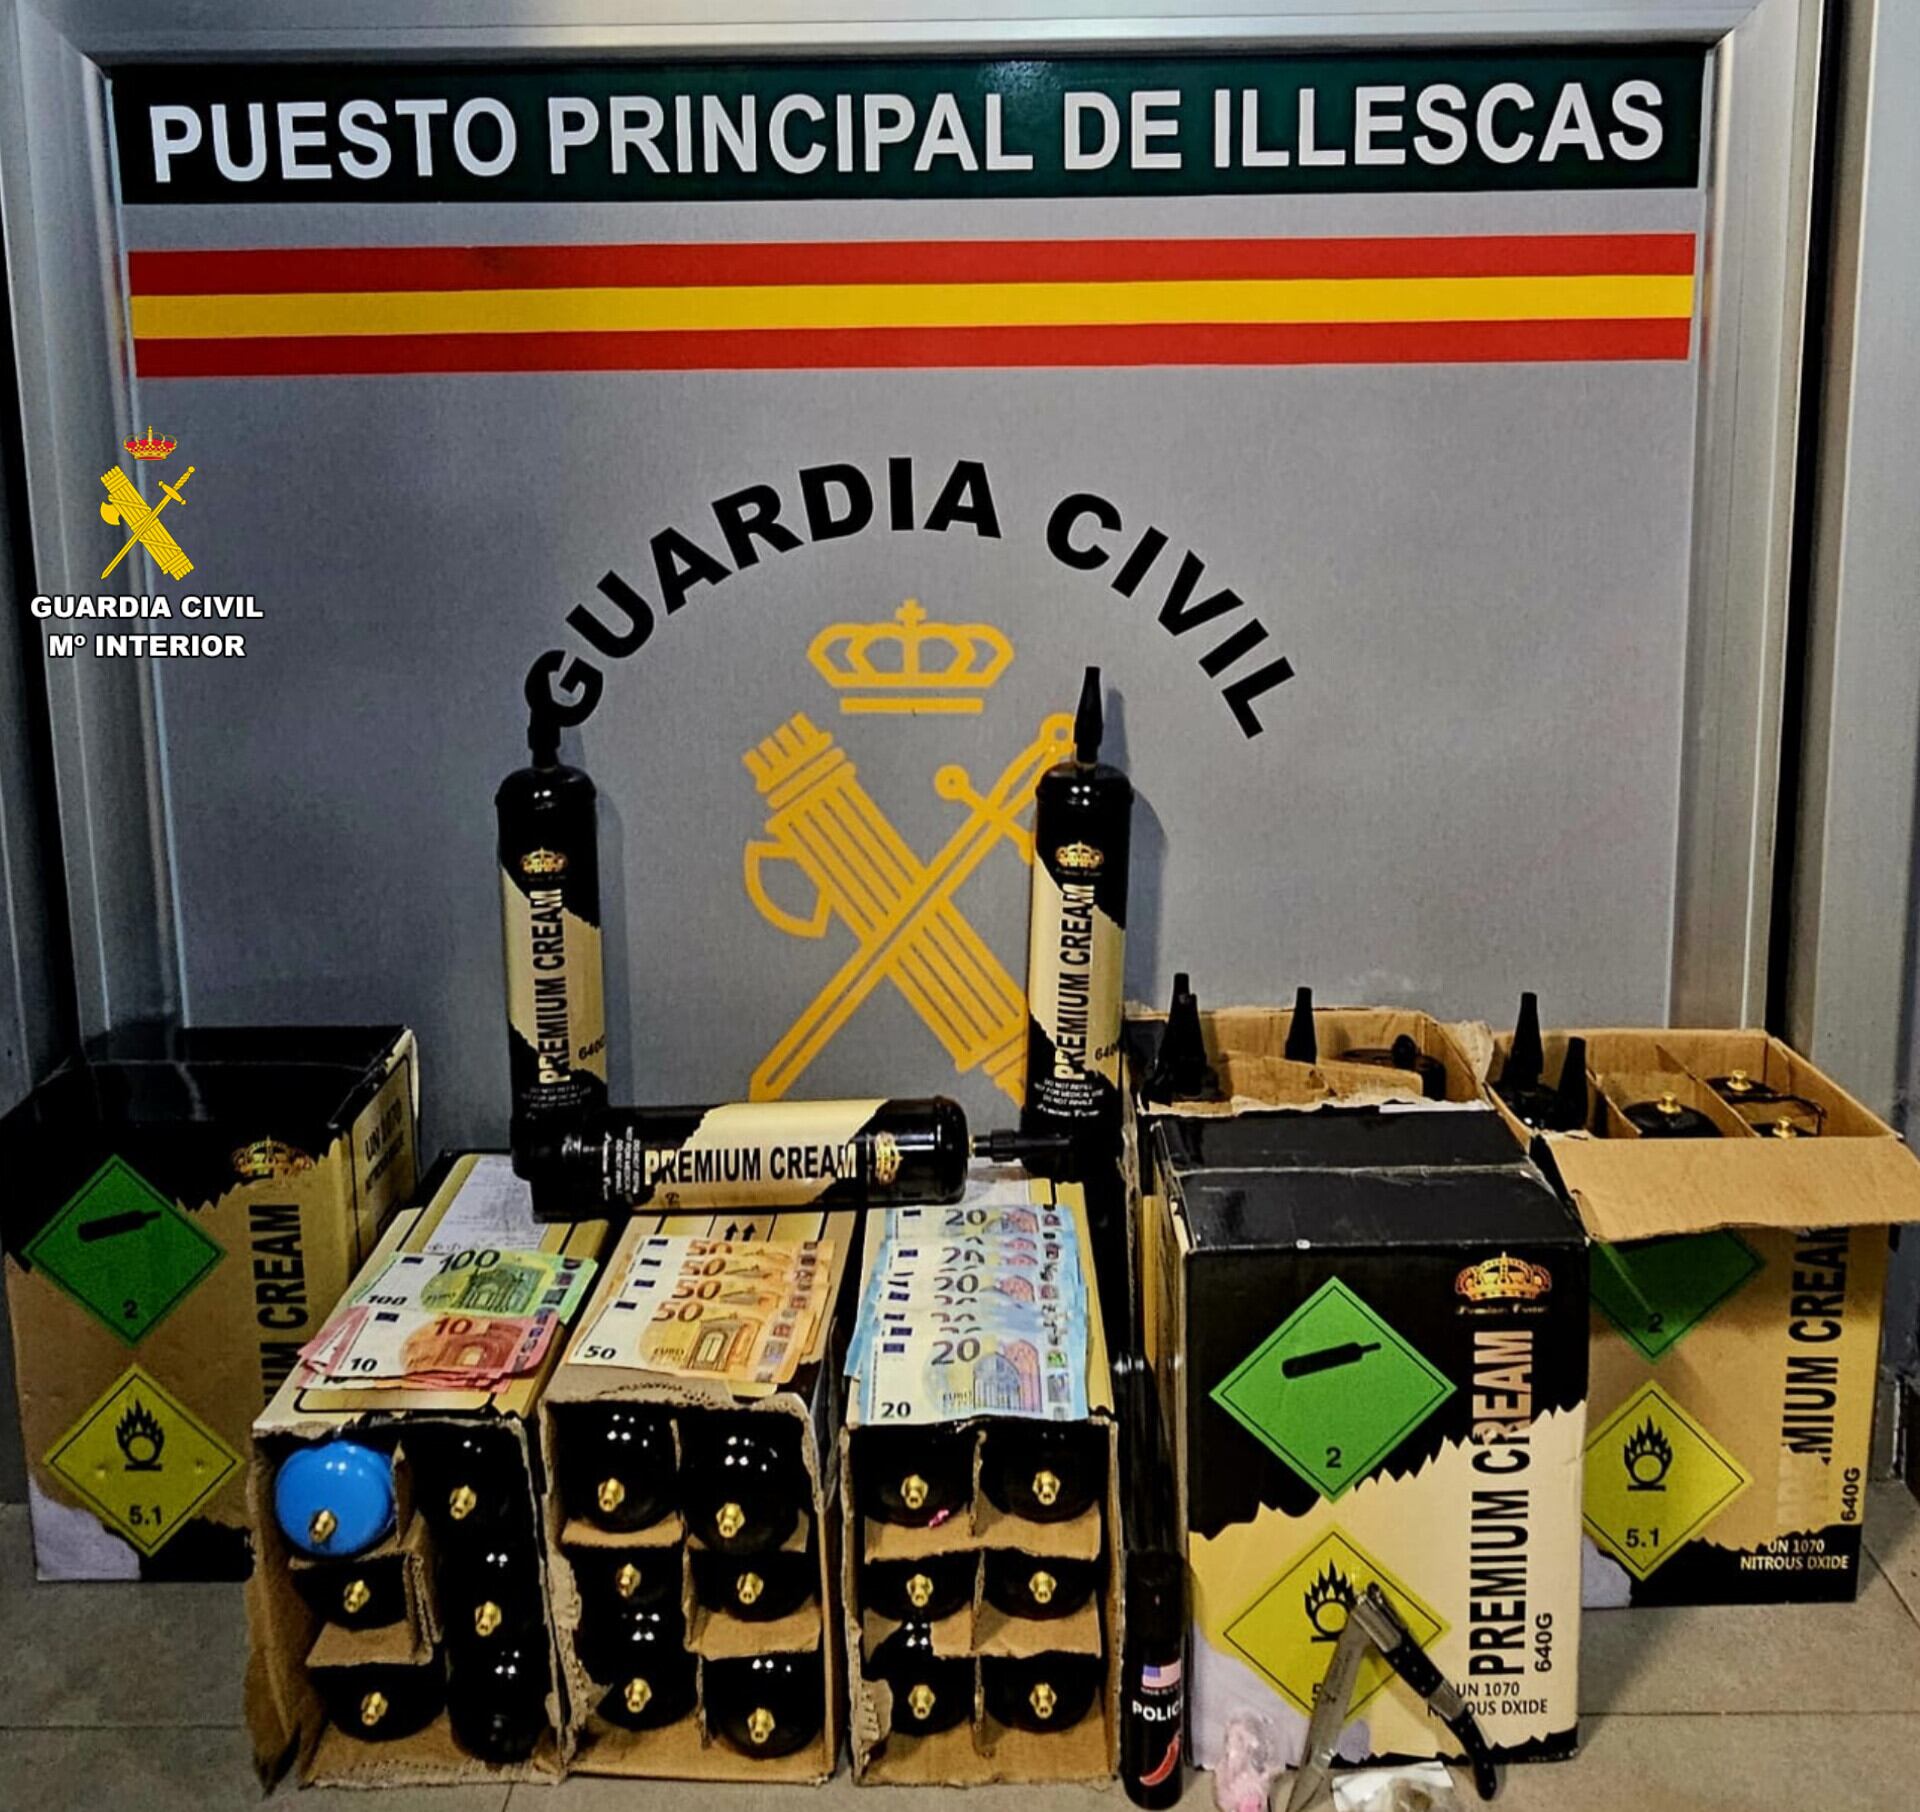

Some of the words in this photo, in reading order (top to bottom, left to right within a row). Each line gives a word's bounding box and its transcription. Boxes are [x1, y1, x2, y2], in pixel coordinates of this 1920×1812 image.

[149, 97, 518, 183] PUESTO
[547, 90, 1034, 174] PRINCIPAL
[1062, 89, 1183, 170] DE
[1213, 79, 1665, 168] ILLESCAS
[524, 457, 1002, 728] GUARDIA
[1045, 493, 1296, 740] CIVIL
[530, 889, 565, 970] CREAM
[1059, 883, 1095, 965] CREAM
[538, 976, 571, 1084] PREMIUM
[1054, 973, 1090, 1081] PREMIUM
[644, 1147, 761, 1186] PREMIUM
[769, 1143, 857, 1181] CREAM
[945, 1209, 987, 1226] 20
[249, 1204, 309, 1330] CREAM
[439, 1250, 501, 1274] 100
[679, 1258, 726, 1276] 50
[672, 1279, 722, 1300] 50
[123, 1301, 138, 1320] 2
[652, 1301, 704, 1322] 50
[434, 1319, 472, 1336] 10
[1647, 1312, 1664, 1333] 2
[583, 1345, 616, 1360] 50
[931, 1338, 981, 1365] 20
[350, 1358, 378, 1372] 10
[881, 1402, 911, 1418] 20
[1471, 1330, 1534, 1474] CREAM
[1325, 1447, 1342, 1468] 2
[1840, 1467, 1861, 1522] 640G
[128, 1505, 163, 1526] 5.1
[1625, 1528, 1660, 1548] 5.1
[1767, 1539, 1789, 1554] UN
[1793, 1538, 1825, 1554] 1070
[1740, 1555, 1804, 1571] NITROUS
[1468, 1489, 1530, 1677] PREMIUM
[1534, 1612, 1553, 1673] 640G
[1456, 1682, 1479, 1698] UN
[1484, 1681, 1520, 1697] 1070
